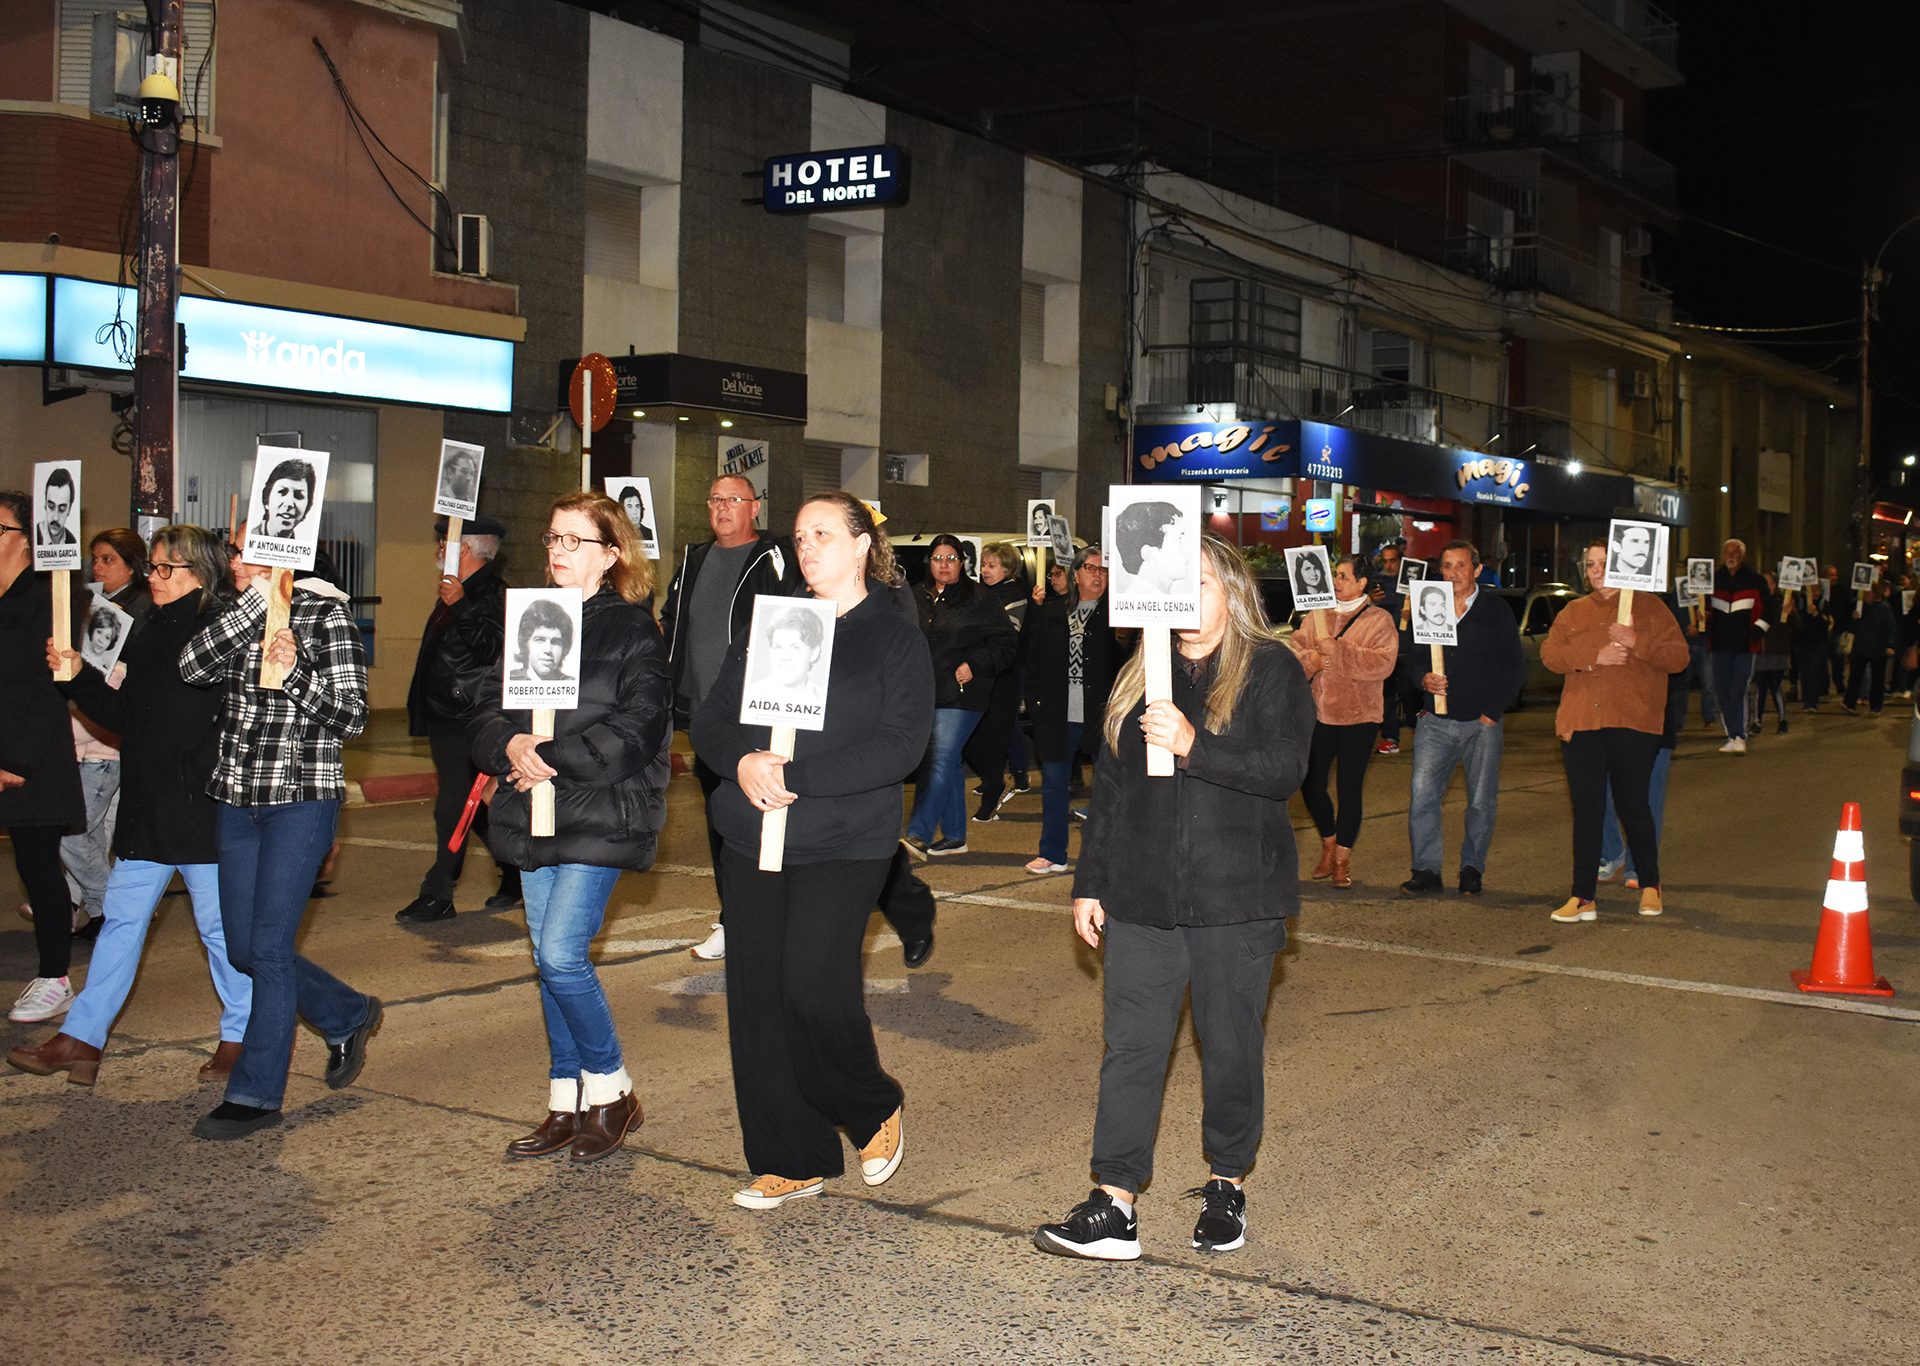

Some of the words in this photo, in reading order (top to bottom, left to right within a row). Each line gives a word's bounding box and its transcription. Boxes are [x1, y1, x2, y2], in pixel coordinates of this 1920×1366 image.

[772, 154, 891, 187] HOTEL
[785, 190, 815, 204] DEL
[822, 184, 876, 201] NORTE
[276, 339, 366, 378] anda
[616, 374, 637, 386] orte
[731, 371, 754, 381] HOTEL
[722, 378, 737, 392] Del
[738, 381, 763, 396] Norte
[726, 443, 746, 460] HOTEL
[1140, 426, 1291, 470] magic
[723, 461, 740, 474] DEL
[740, 445, 766, 472] NORTE
[1307, 463, 1343, 479] 47733213
[1458, 459, 1530, 499] magic
[456, 503, 474, 512] CASTILLO
[257, 541, 285, 552] ANTONIA
[286, 545, 311, 556] CASTRO
[1115, 601, 1135, 610] JUAN
[508, 686, 544, 695] ROBERTO
[546, 686, 576, 695] CASTRO
[785, 703, 822, 716] SANZ
